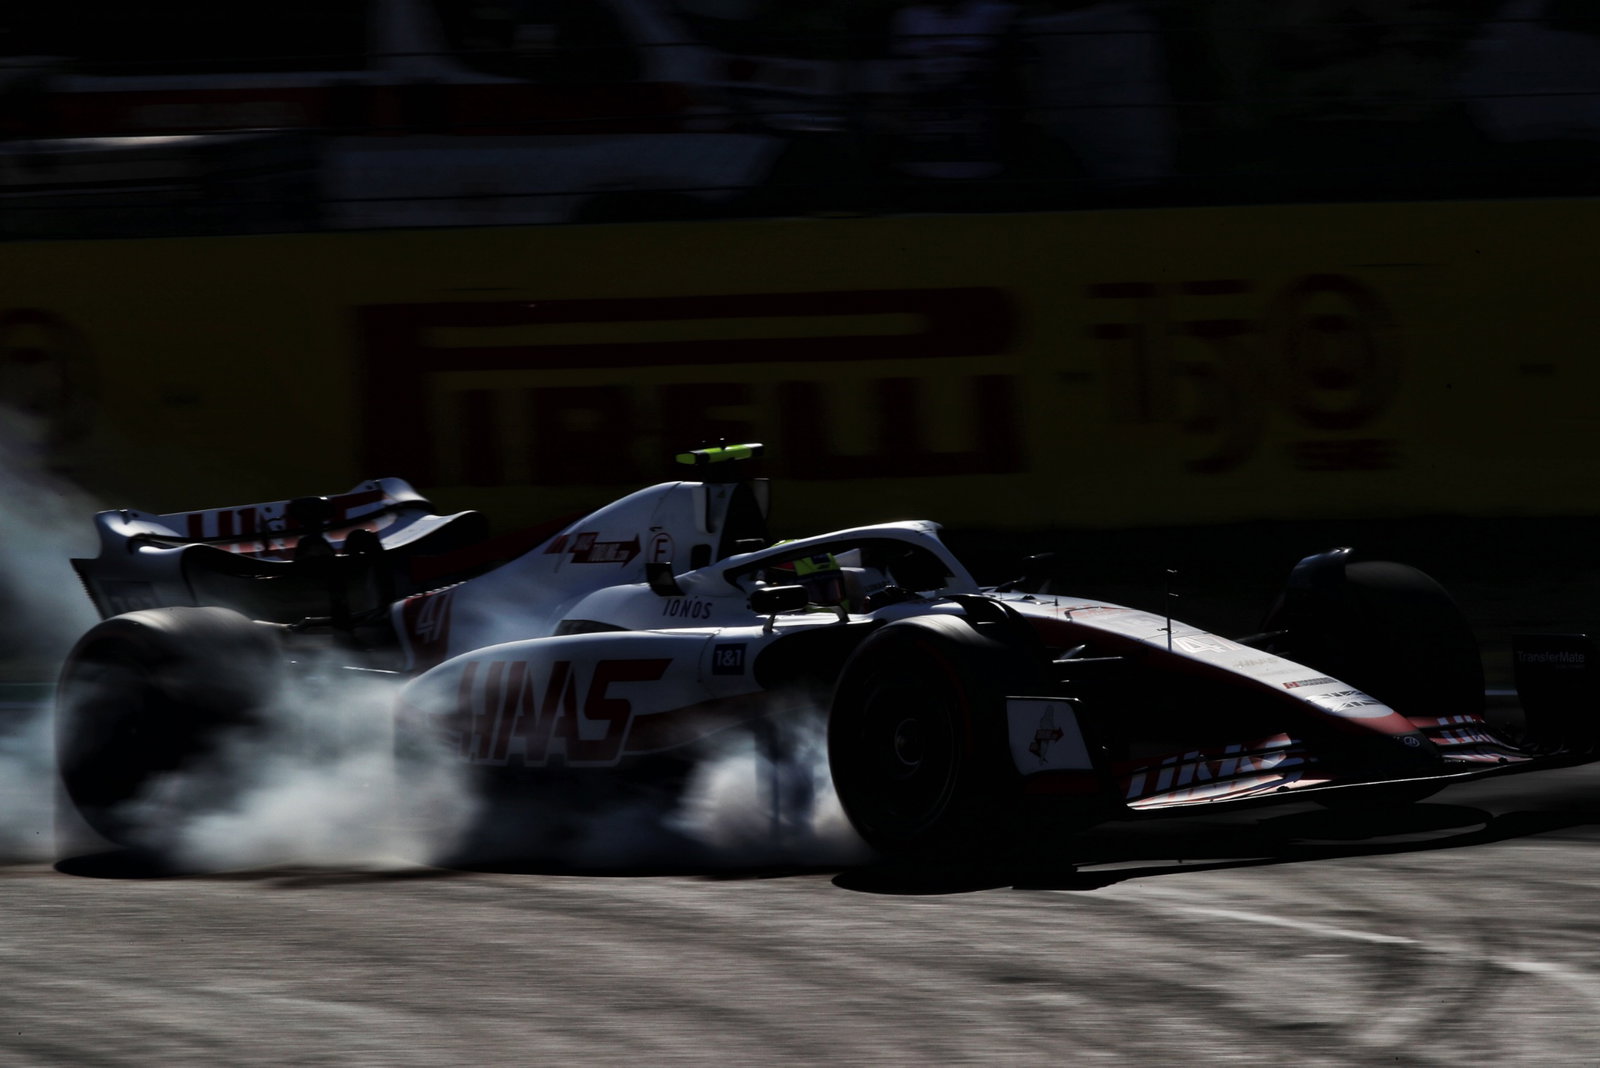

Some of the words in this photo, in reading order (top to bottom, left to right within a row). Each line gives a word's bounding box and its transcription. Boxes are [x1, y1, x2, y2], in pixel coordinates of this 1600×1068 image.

[358, 286, 1022, 485] PIRELLI
[662, 599, 713, 619] IONOS
[716, 649, 742, 667] 1&1
[1517, 650, 1585, 662] TransferMate
[456, 658, 674, 764] HAAS
